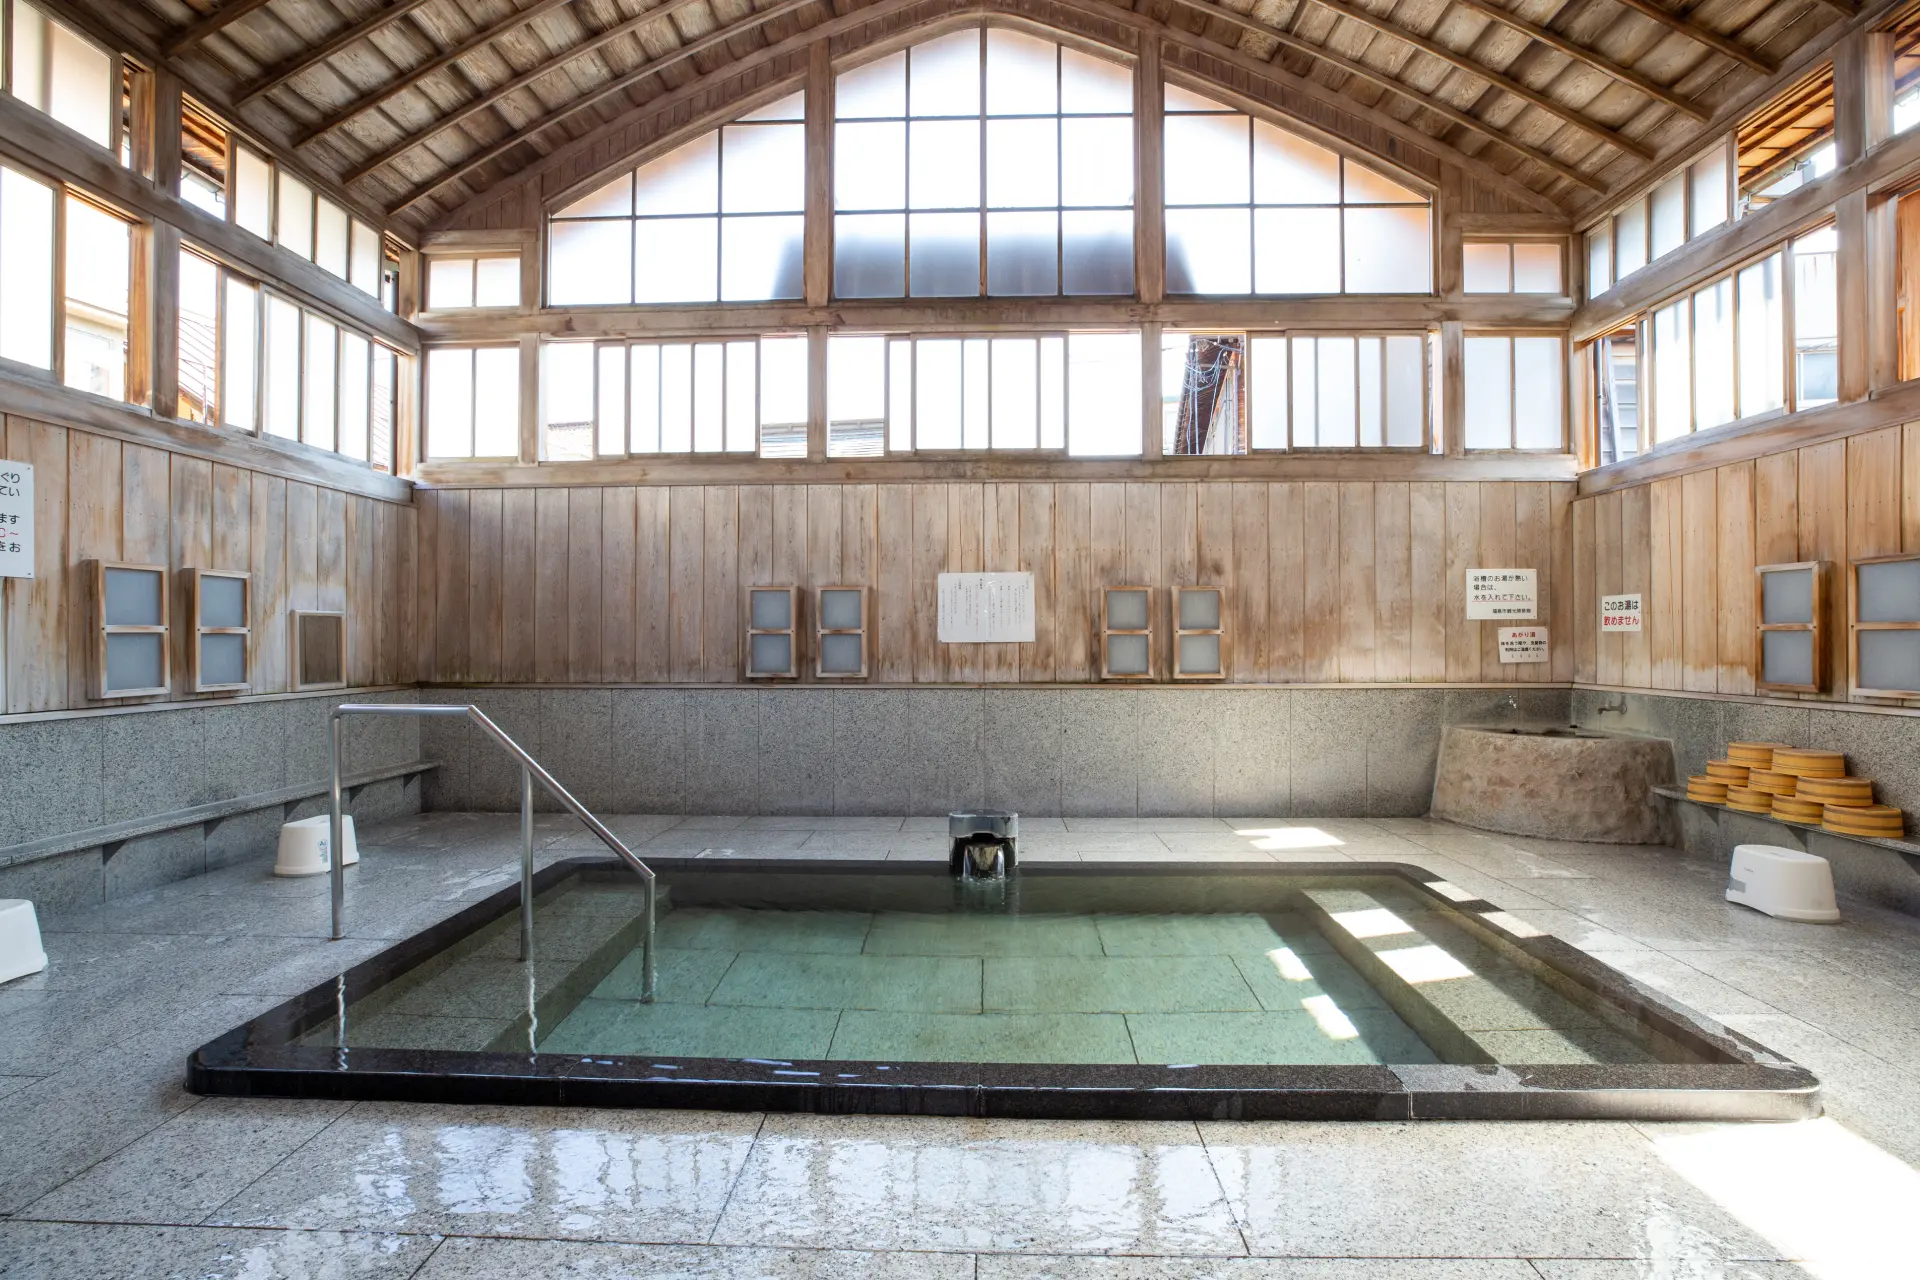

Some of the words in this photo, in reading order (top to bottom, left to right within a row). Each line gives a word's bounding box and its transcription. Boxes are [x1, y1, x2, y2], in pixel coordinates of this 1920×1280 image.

[1, 472, 20, 483] ぐり
[1473, 574, 1529, 582] 浴槽のお湯が熱い
[1604, 600, 1639, 611] このお湯は
[1603, 615, 1640, 626] 飲めません
